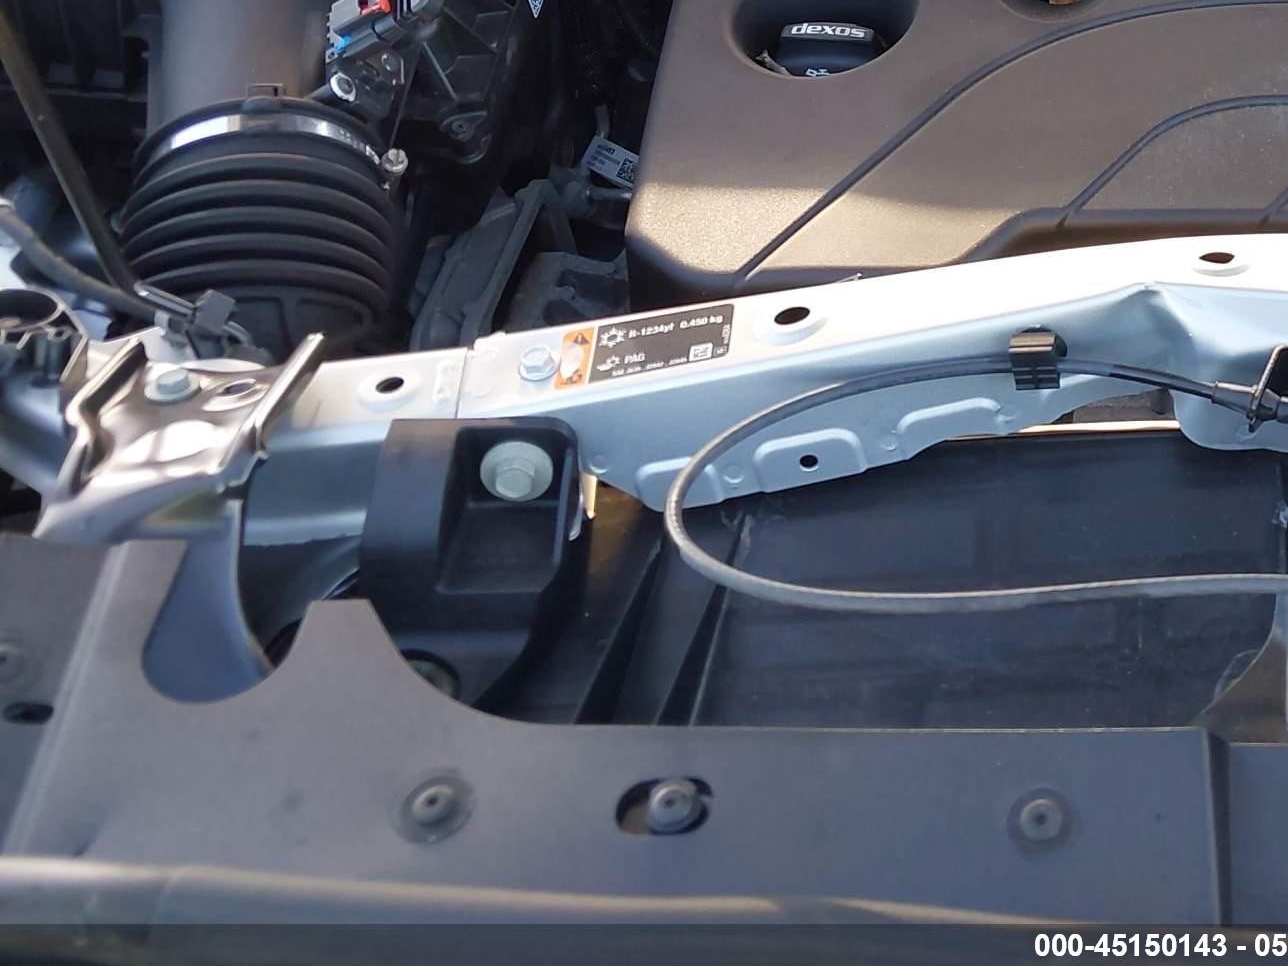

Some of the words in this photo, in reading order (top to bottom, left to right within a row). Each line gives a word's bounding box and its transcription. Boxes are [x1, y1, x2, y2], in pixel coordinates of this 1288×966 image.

[791, 22, 868, 38] dexos
[628, 322, 675, 338] R-1234yf
[680, 316, 707, 329] 0.450
[710, 314, 723, 325] kg
[624, 352, 645, 364] PAG
